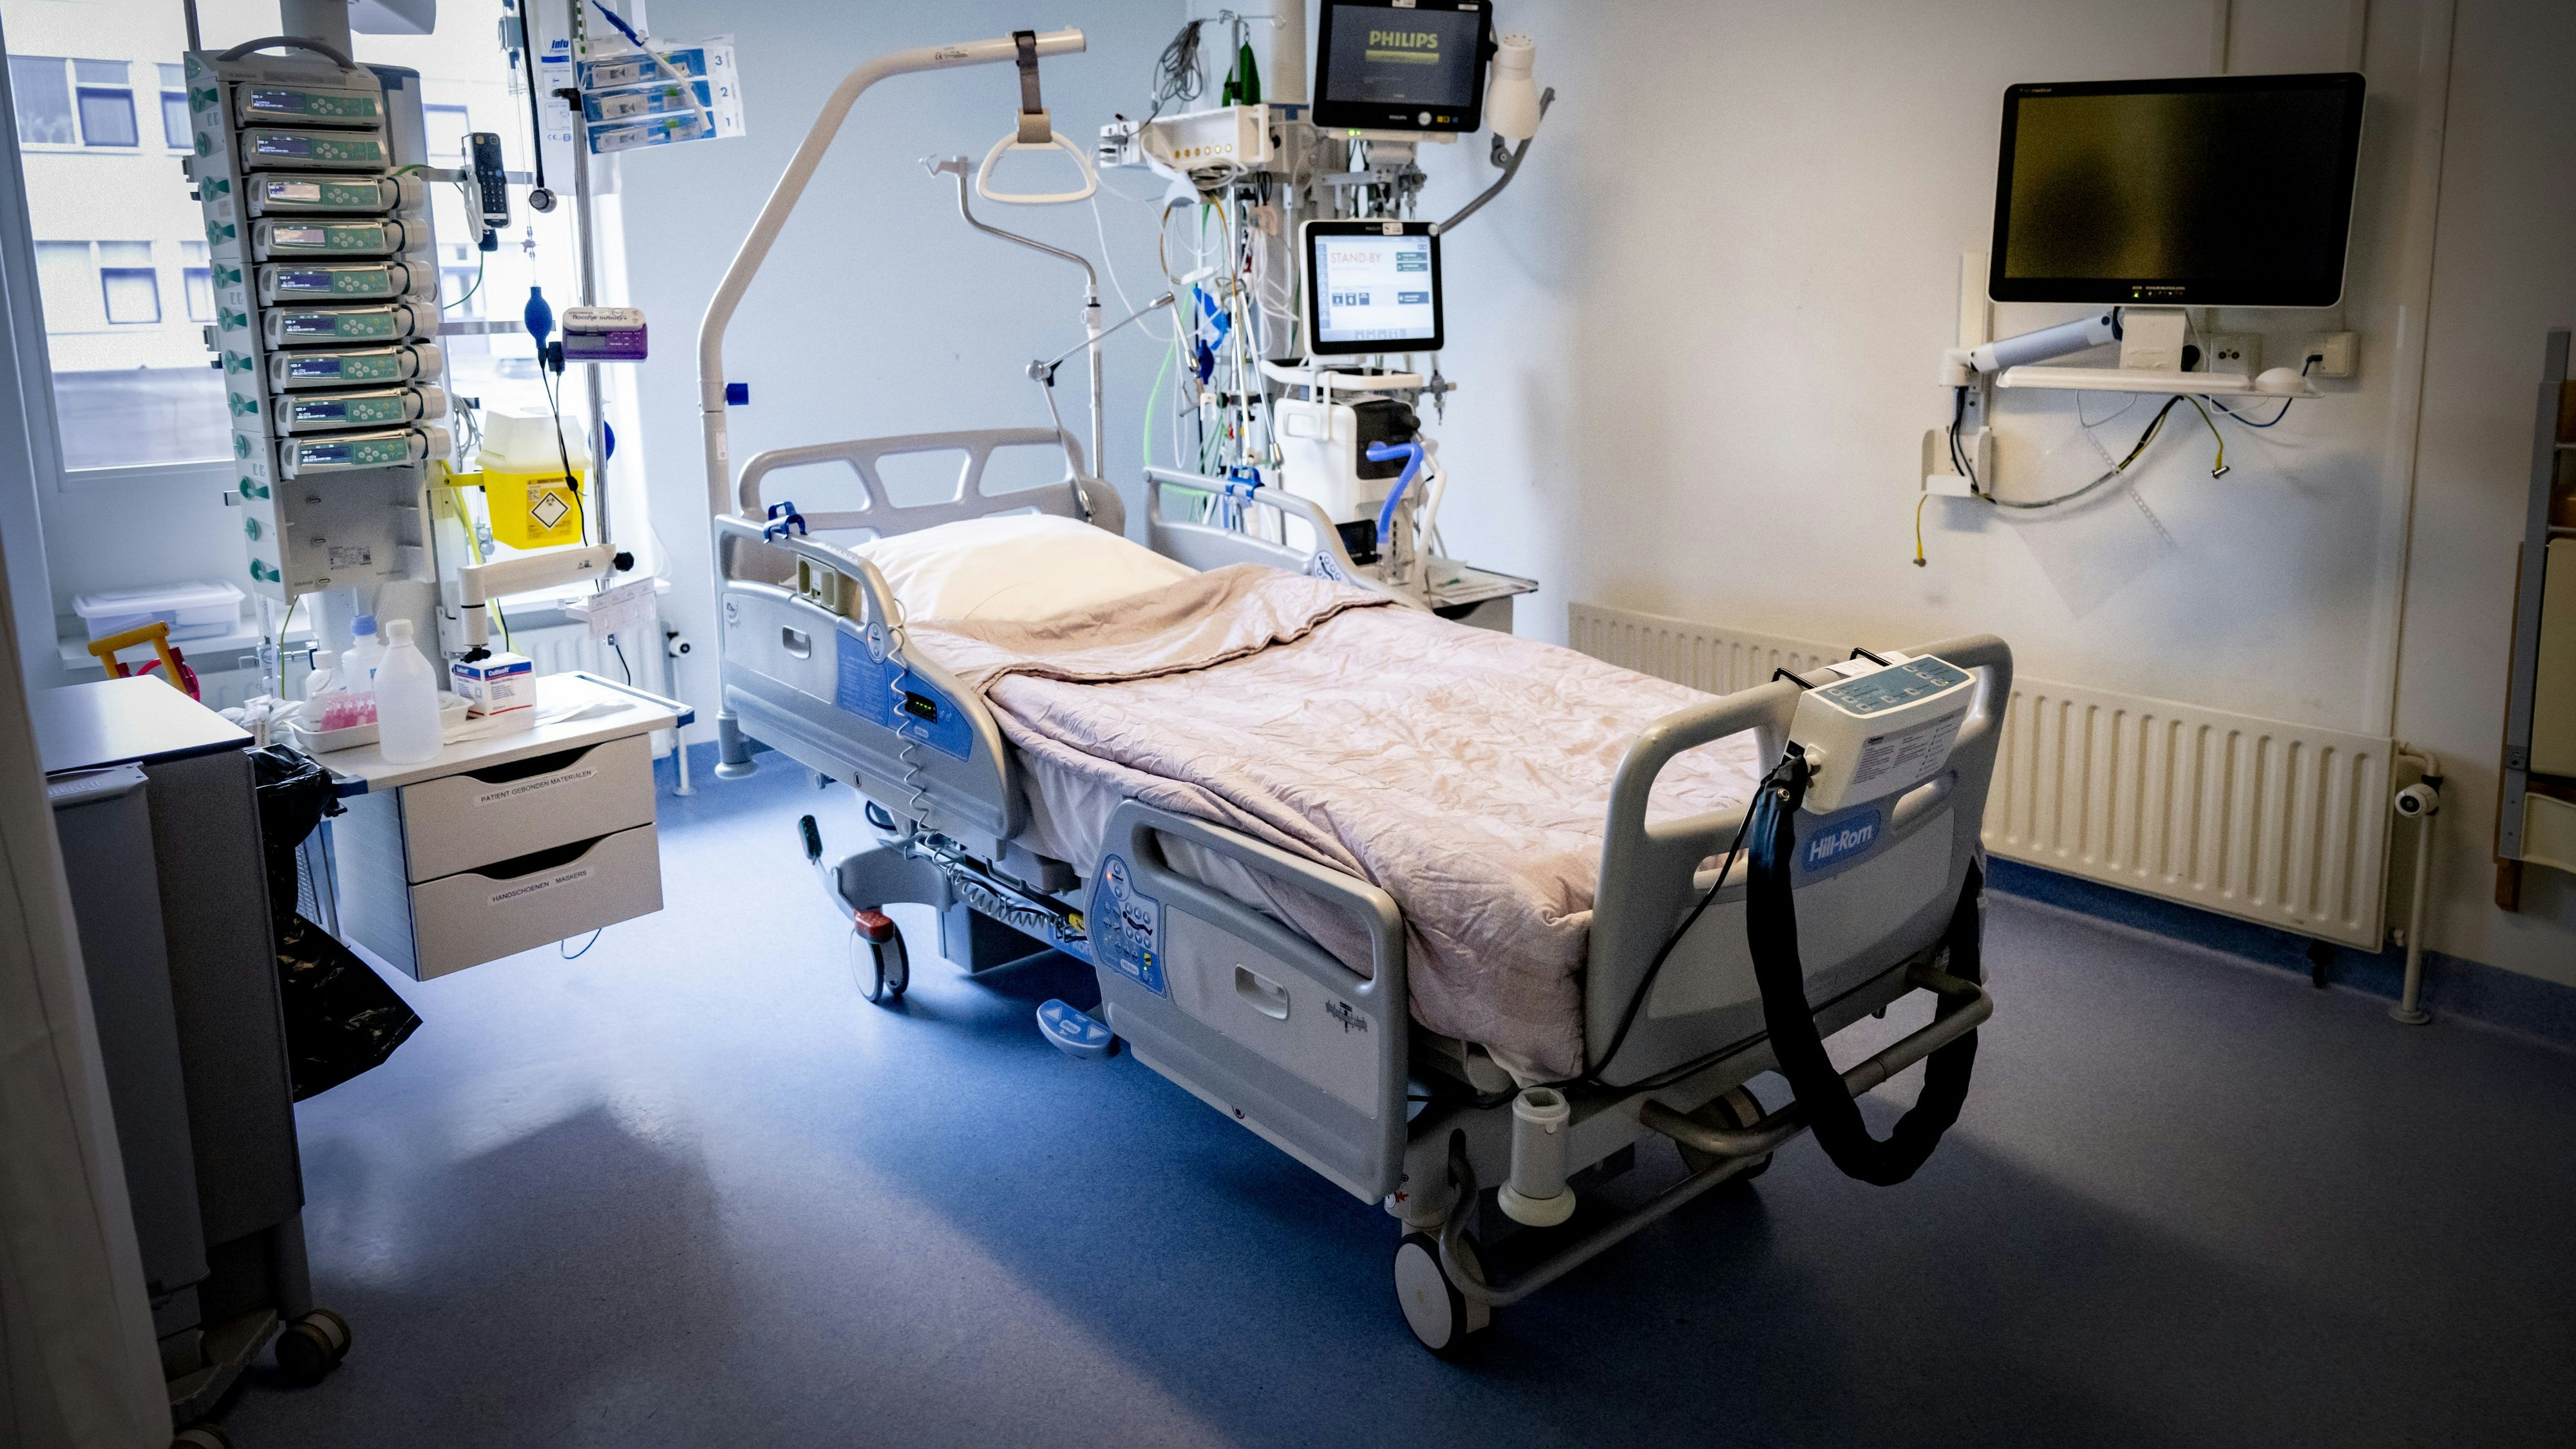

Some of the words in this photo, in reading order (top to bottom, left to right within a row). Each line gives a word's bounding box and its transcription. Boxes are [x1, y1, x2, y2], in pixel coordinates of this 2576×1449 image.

[1370, 30, 1438, 49] PHILIPS
[715, 55, 723, 66] 3
[720, 87, 728, 97] 2
[725, 117, 730, 127] 1
[1330, 252, 1381, 263] STAND-BY
[488, 667, 509, 676] Cutisoft
[481, 790, 509, 802] PATIENT
[511, 781, 549, 795] GEBONDEN
[551, 770, 592, 785] MATERIALEN
[1810, 825, 1872, 862] Hill-Rom
[493, 881, 549, 902] HANDSCHOENEN
[556, 870, 587, 884] MASKERS
